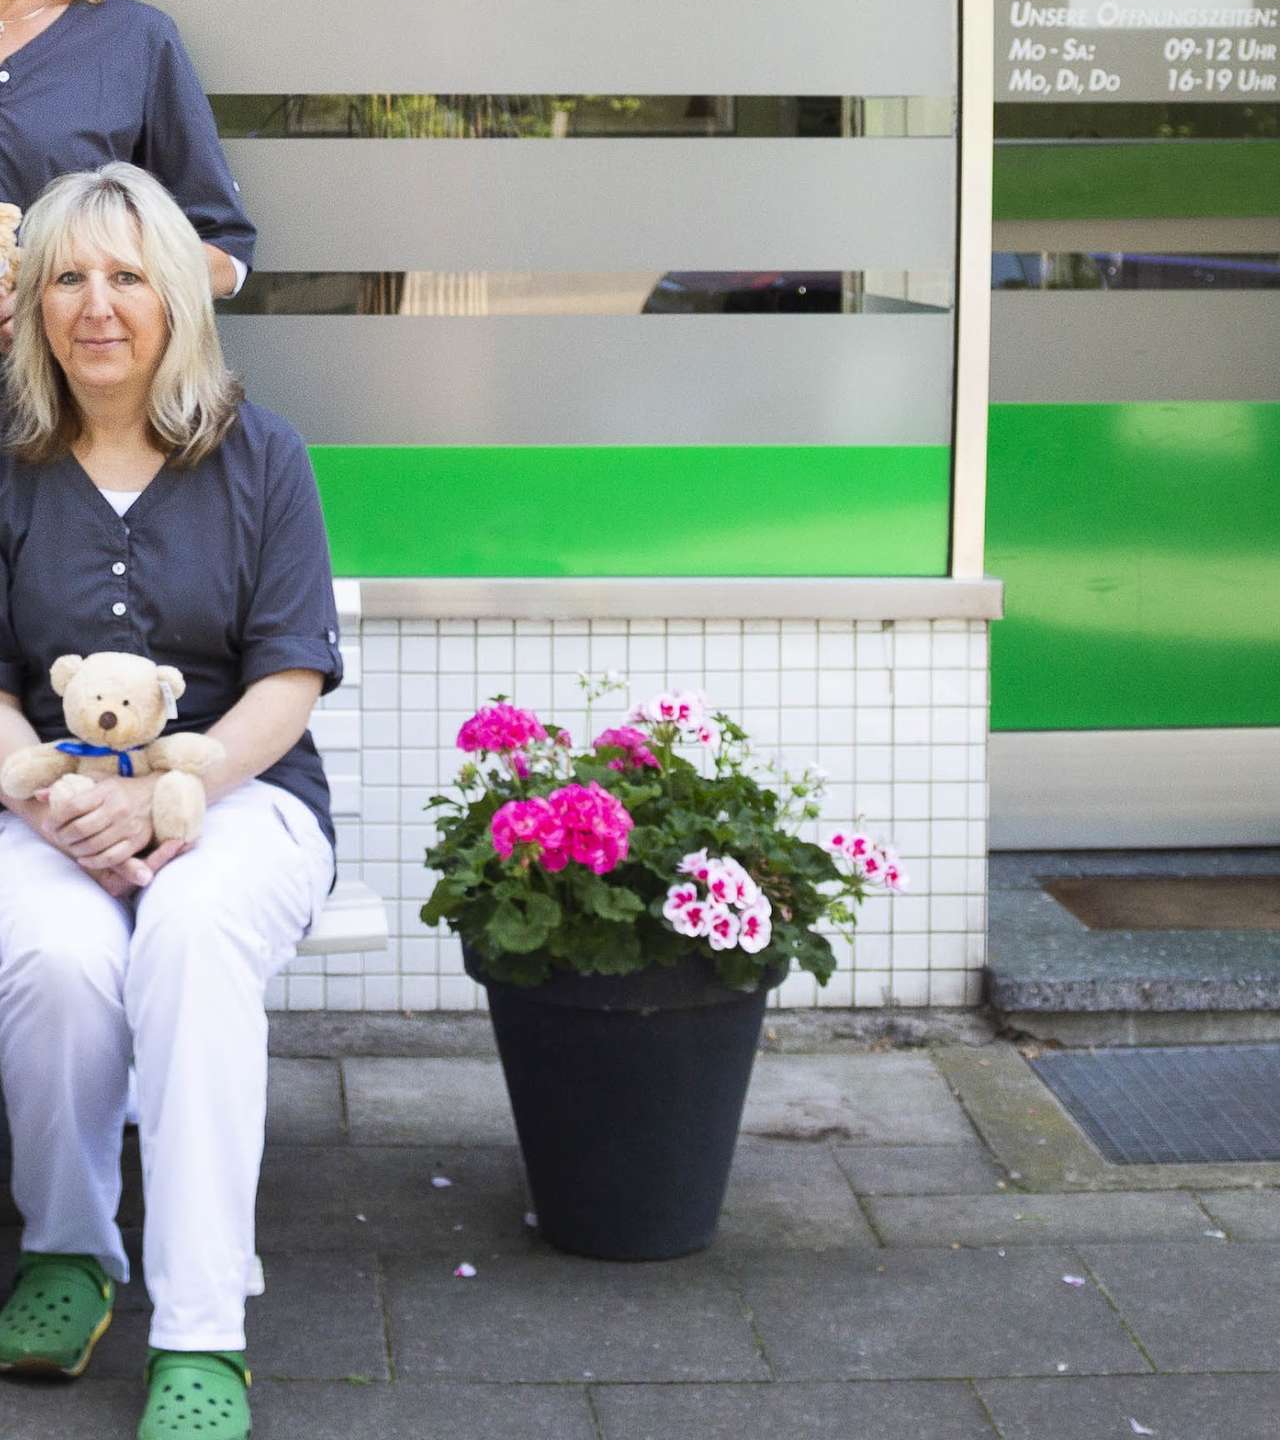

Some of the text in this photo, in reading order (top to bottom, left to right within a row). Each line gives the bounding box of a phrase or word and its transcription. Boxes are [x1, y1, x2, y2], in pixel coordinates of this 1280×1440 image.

[1164, 37, 1277, 61] 09-12 UHR
[1088, 69, 1121, 92] DO
[1168, 68, 1277, 92] 16-19 UHR
